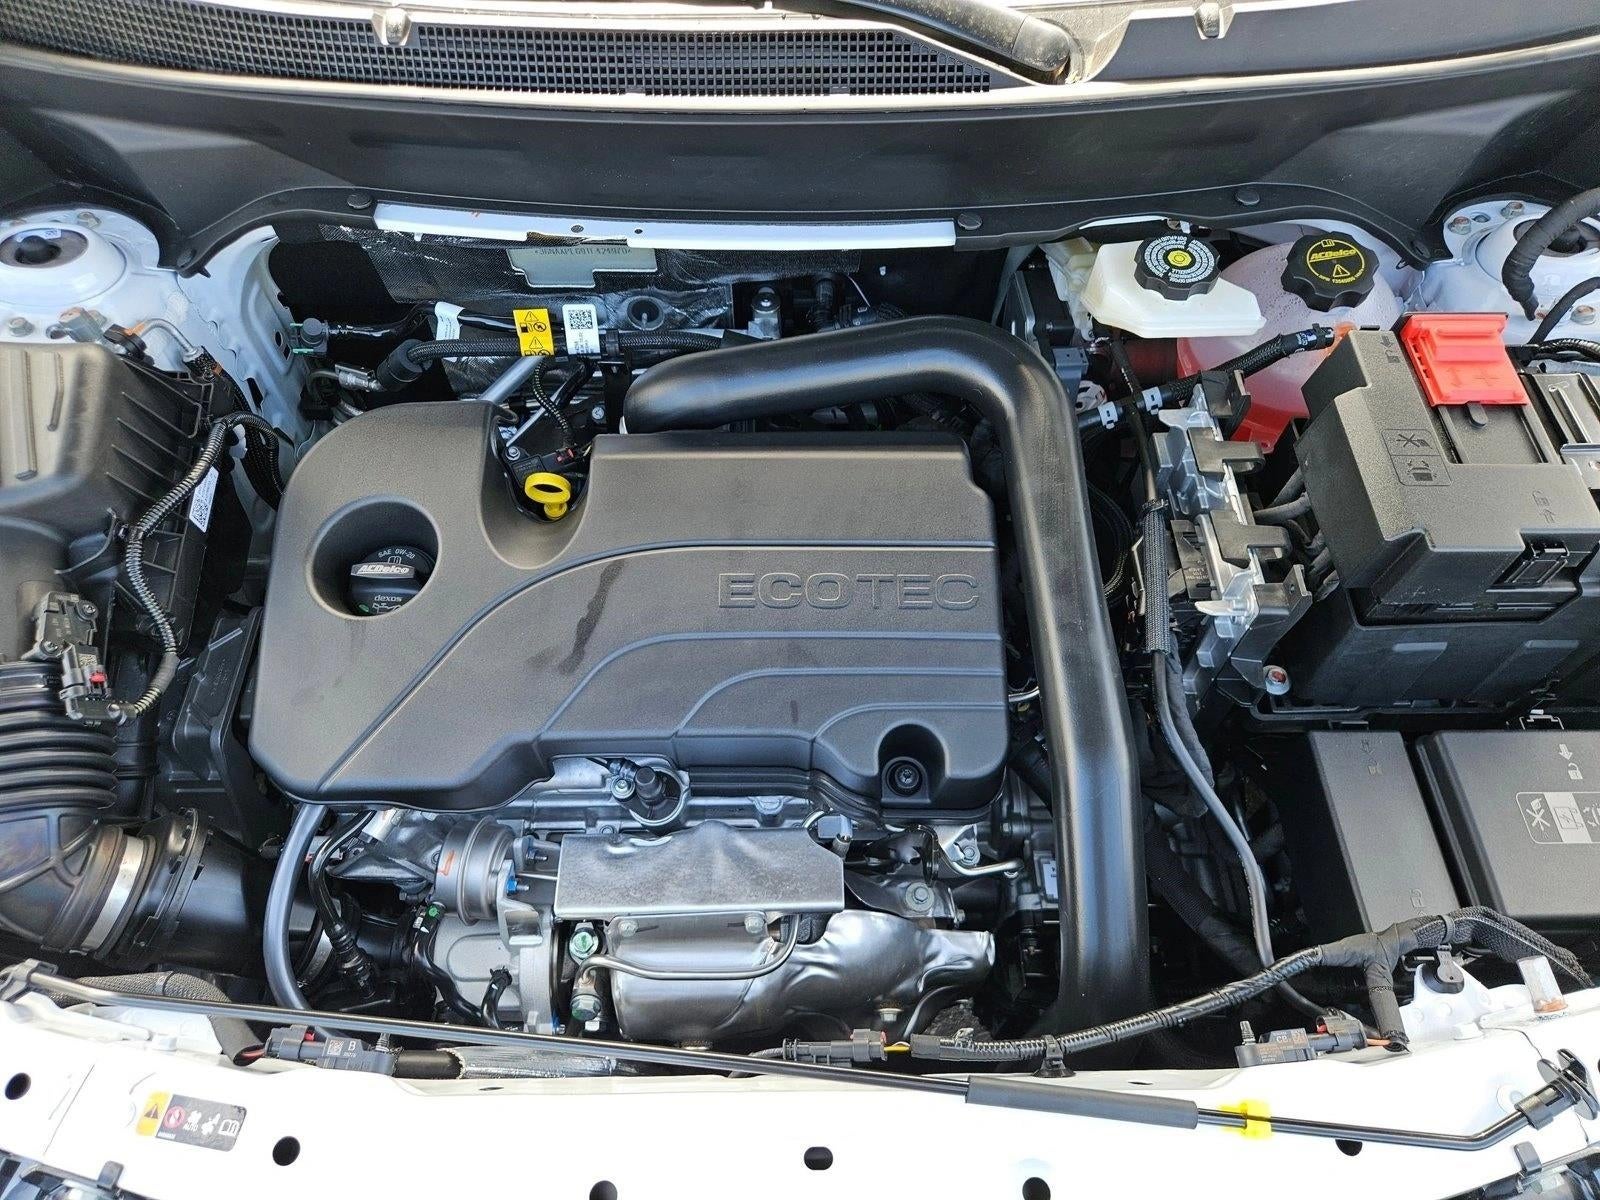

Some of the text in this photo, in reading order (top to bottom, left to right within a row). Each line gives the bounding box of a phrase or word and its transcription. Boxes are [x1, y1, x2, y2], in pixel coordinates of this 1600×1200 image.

[1310, 249, 1356, 261] ACDelco
[378, 548, 416, 559] SAE 0W-20
[357, 564, 410, 575] ACDelco
[719, 573, 980, 610] ECOTEC
[348, 1041, 356, 1051] B
